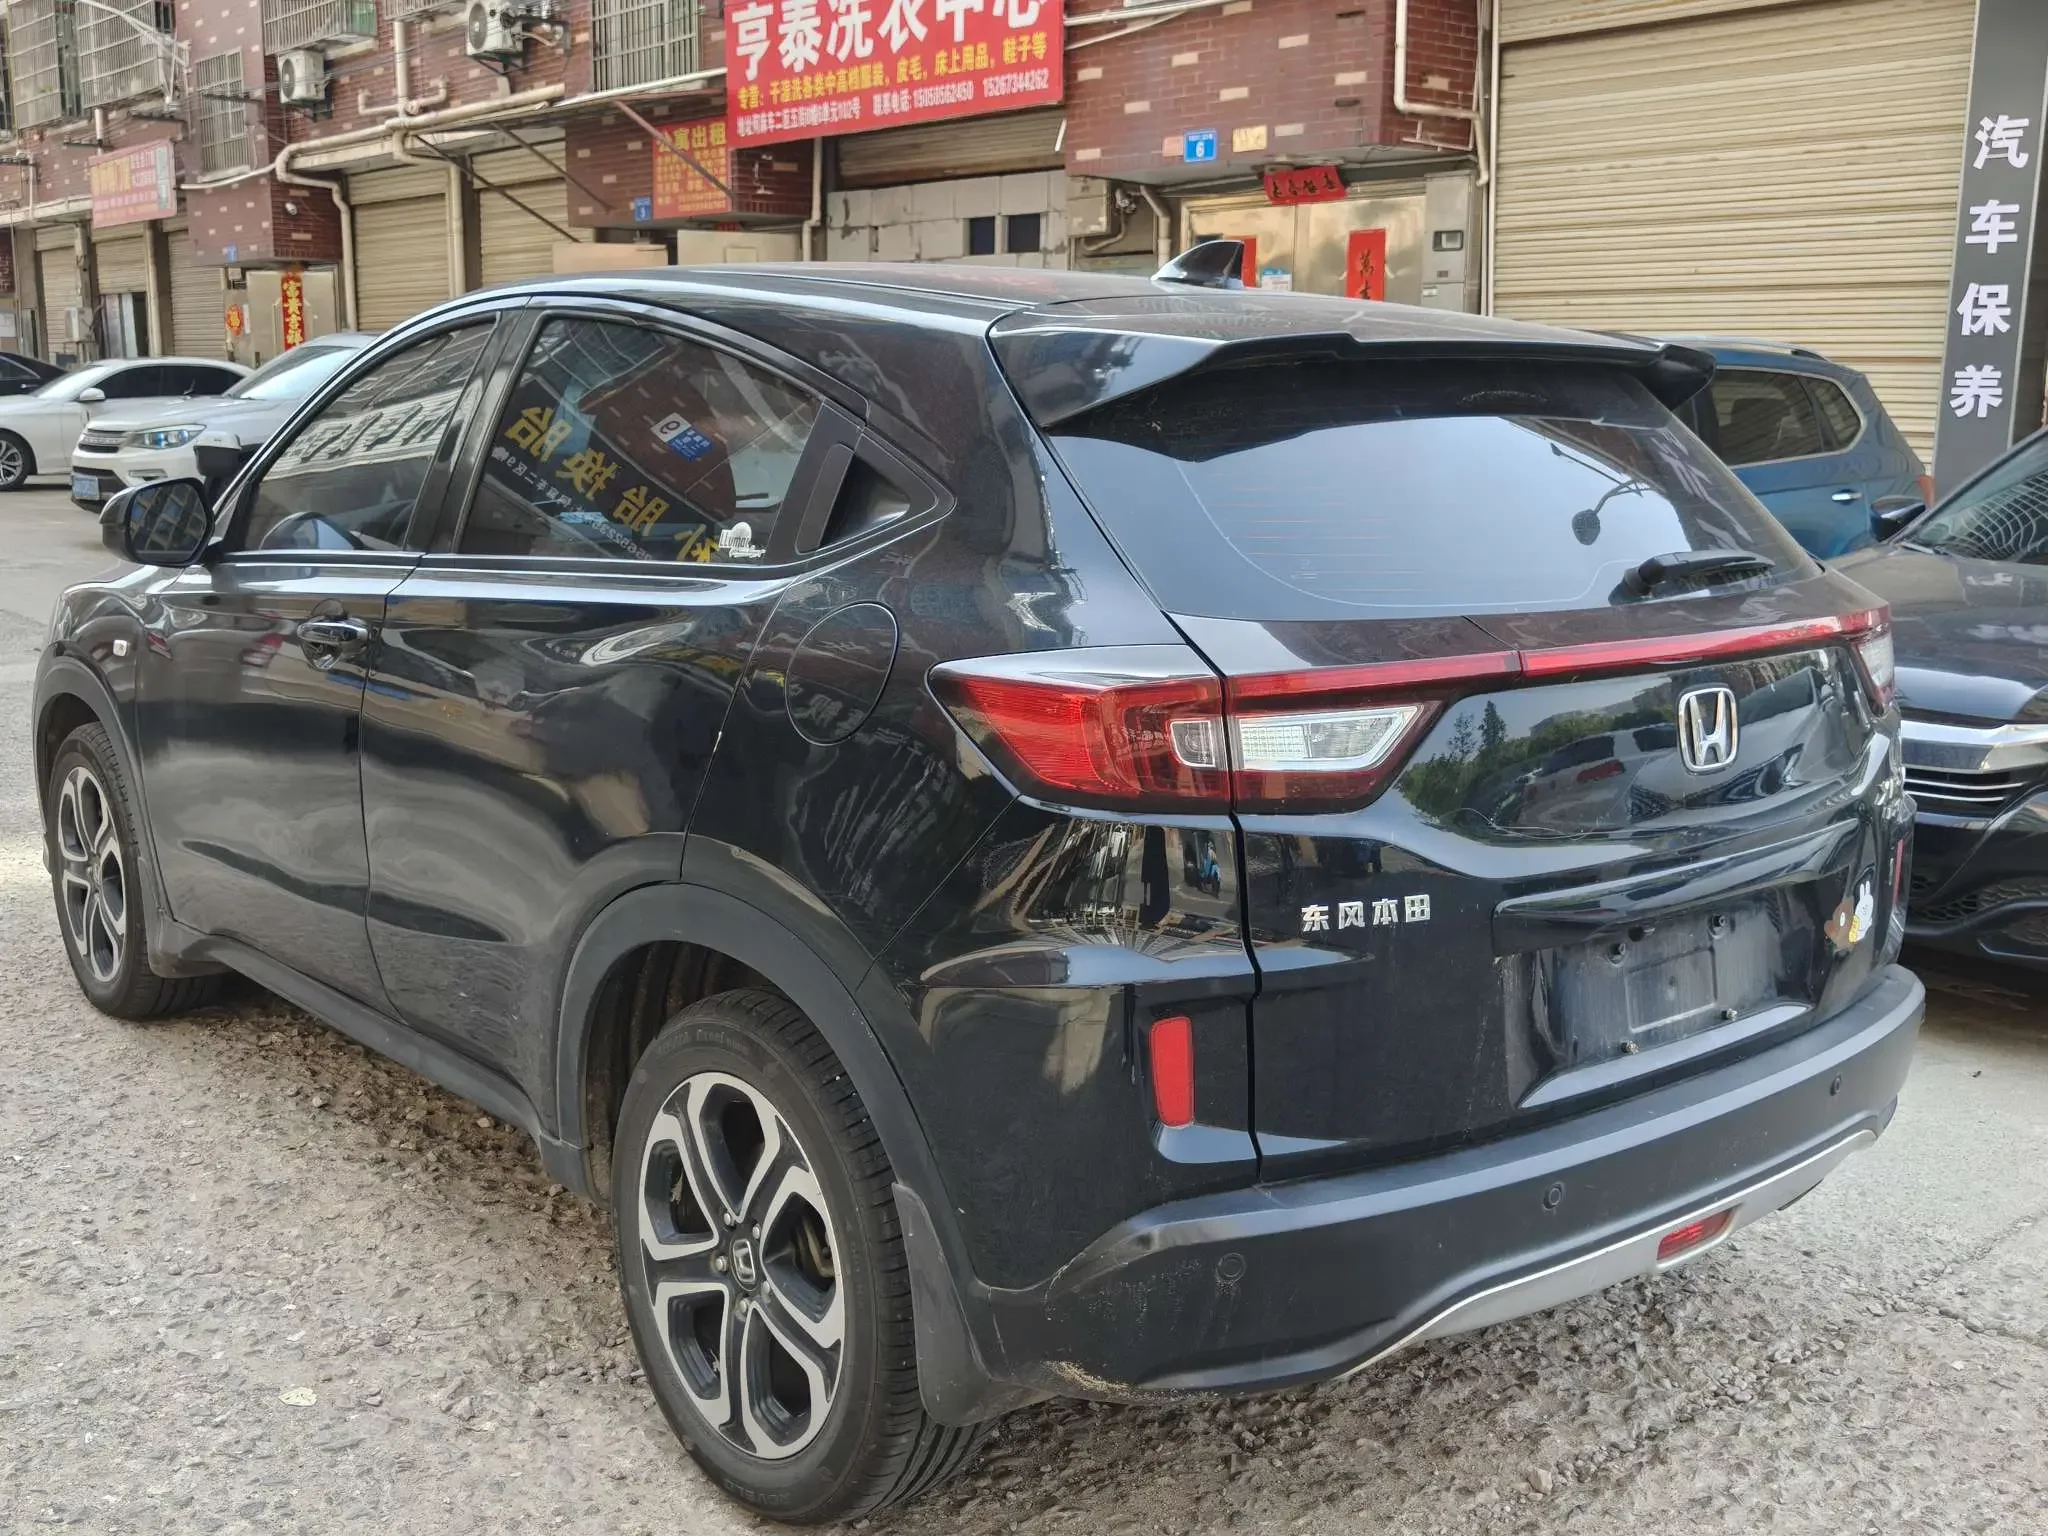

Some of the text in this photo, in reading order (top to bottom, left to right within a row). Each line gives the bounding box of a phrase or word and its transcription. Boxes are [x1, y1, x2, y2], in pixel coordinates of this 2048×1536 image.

[1950, 114, 2029, 418] 汽车保养
[1301, 894, 1431, 932] 东风本田
